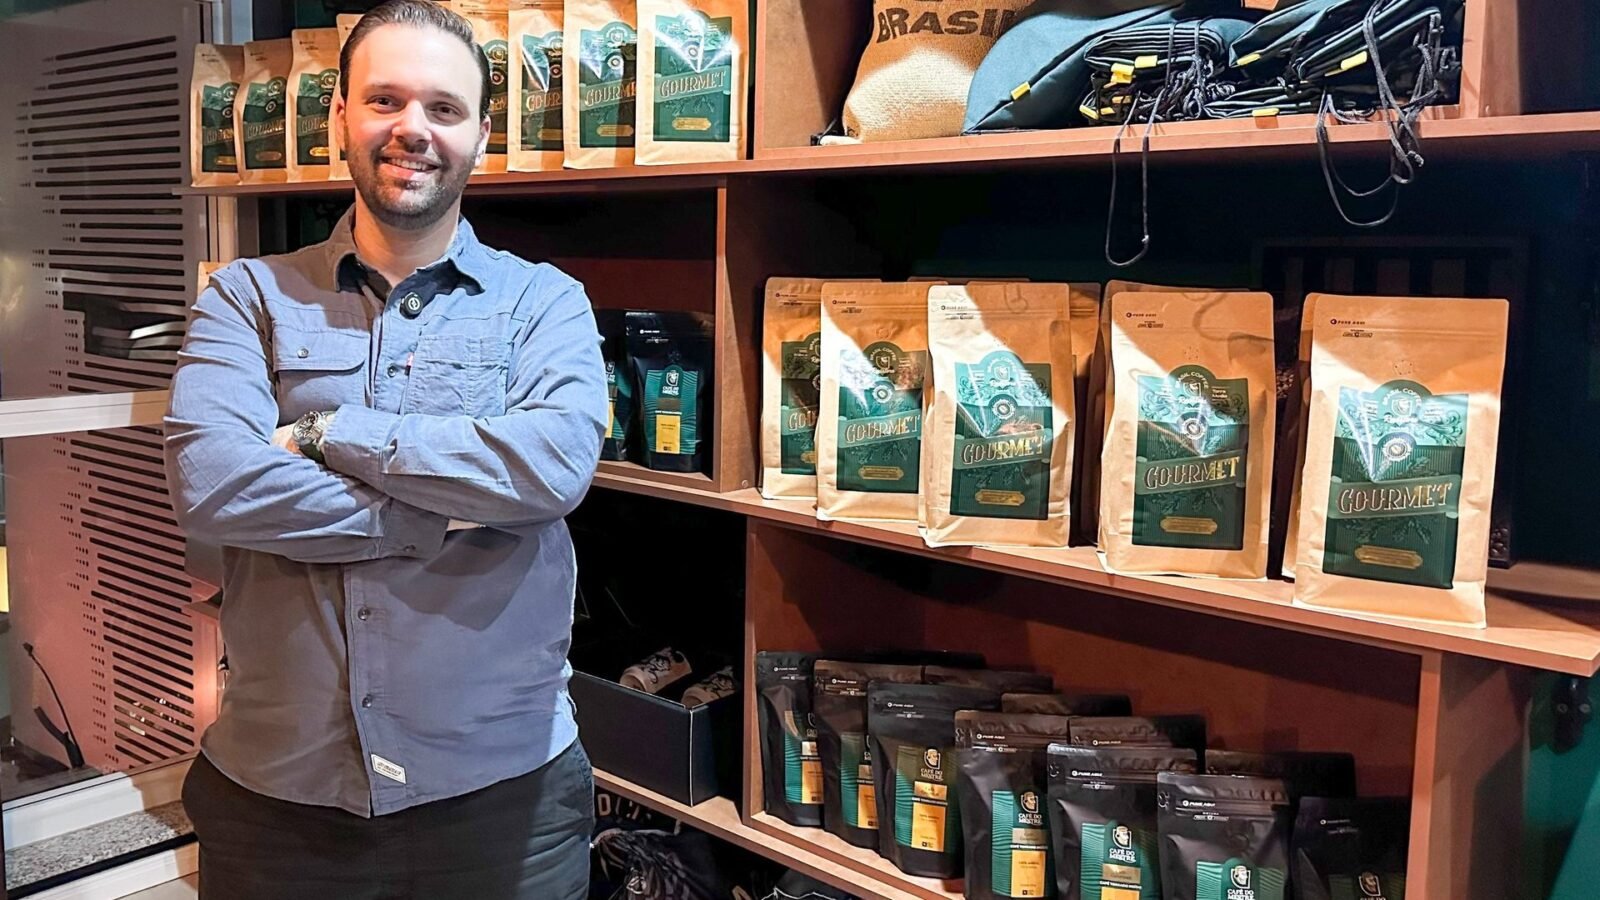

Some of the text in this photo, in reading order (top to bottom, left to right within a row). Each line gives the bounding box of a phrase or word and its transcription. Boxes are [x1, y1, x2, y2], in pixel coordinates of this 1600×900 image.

[585, 81, 636, 106] GOURM
[661, 70, 726, 98] GOURMET
[526, 92, 562, 112] GOUR
[846, 415, 920, 443] GOURMET
[962, 434, 1046, 465] GOURMET
[1145, 456, 1240, 489] GOURMET
[1339, 483, 1452, 514] GOURMET
